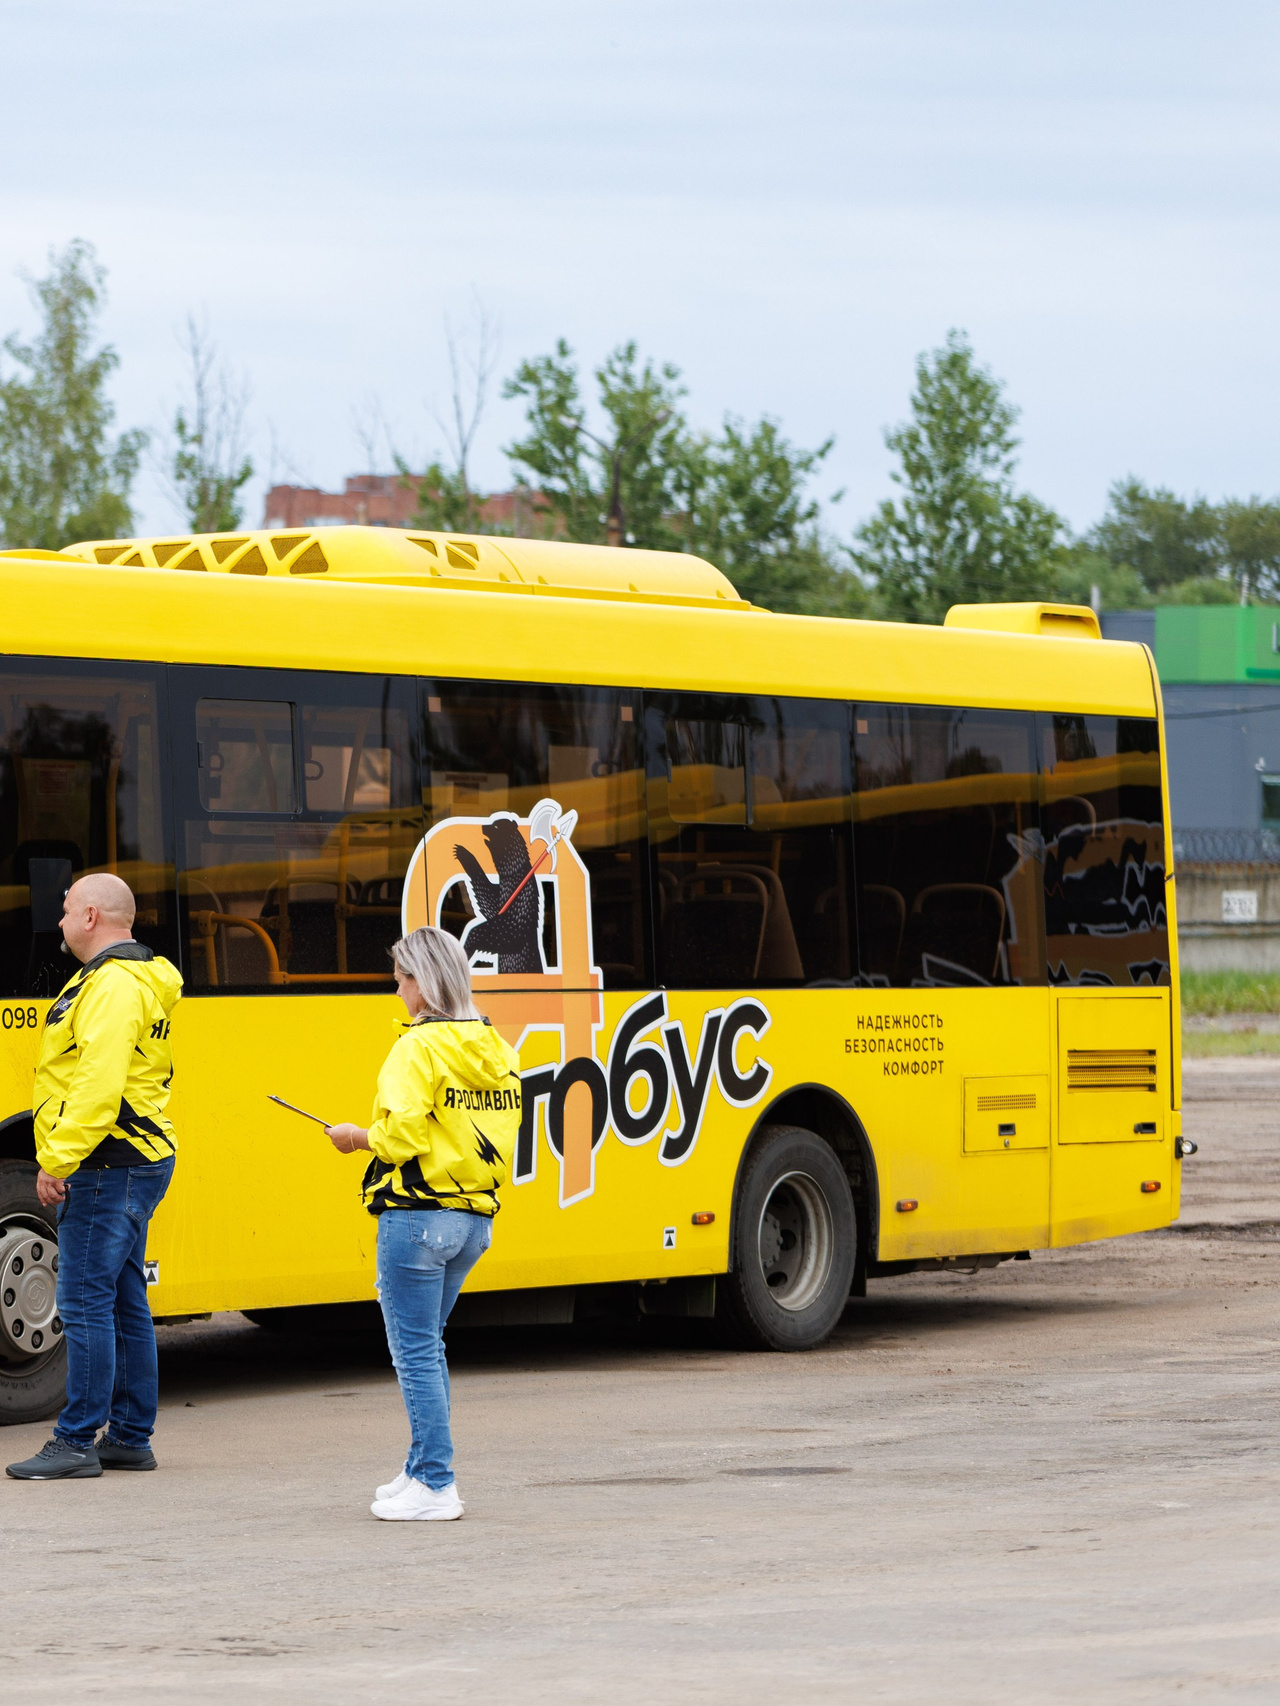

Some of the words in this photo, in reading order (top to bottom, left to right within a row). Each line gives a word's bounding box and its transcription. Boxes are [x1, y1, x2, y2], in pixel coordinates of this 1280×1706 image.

[857, 1014, 944, 1032] НАДЕЖНОСТЬ
[845, 1037, 945, 1053] БЕЗОПАСНОСТЬ
[883, 1060, 945, 1076] КОМФОРТ
[443, 1087, 520, 1111] ЯРОСЛАВЛЬ
